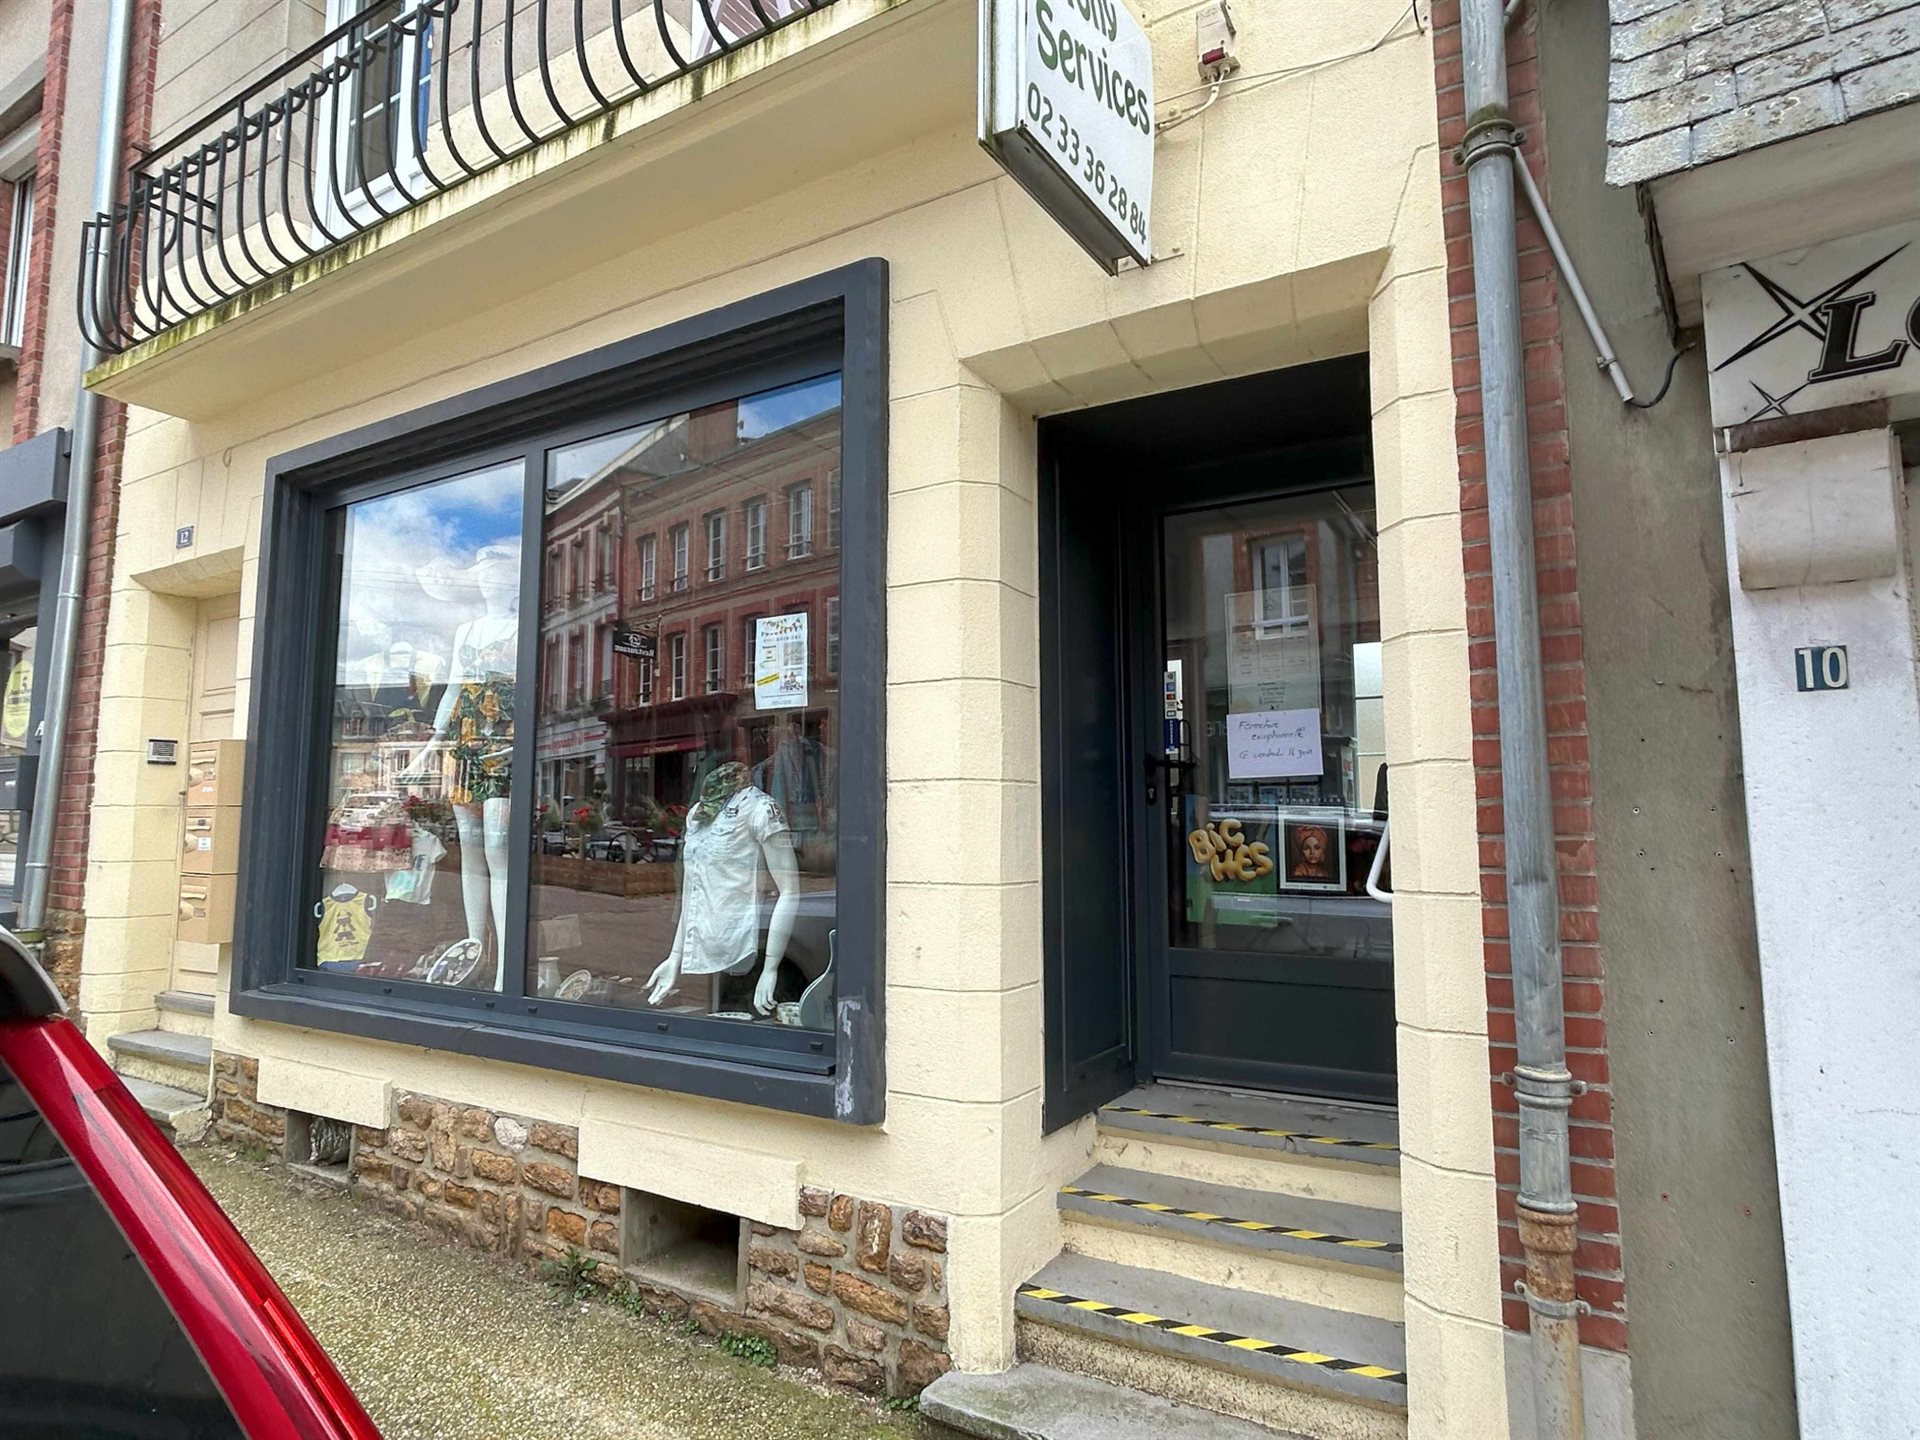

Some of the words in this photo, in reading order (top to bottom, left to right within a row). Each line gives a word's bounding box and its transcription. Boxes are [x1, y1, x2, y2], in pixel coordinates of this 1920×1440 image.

[1036, 0, 1151, 136] Services
[1028, 82, 1053, 139] 02
[1057, 114, 1080, 166] 33
[1084, 145, 1105, 196] 36
[1108, 174, 1127, 221] 28
[1130, 201, 1147, 245] 84
[1807, 290, 1920, 385] L
[180, 531, 189, 544] 12
[1798, 646, 1848, 689] 10
